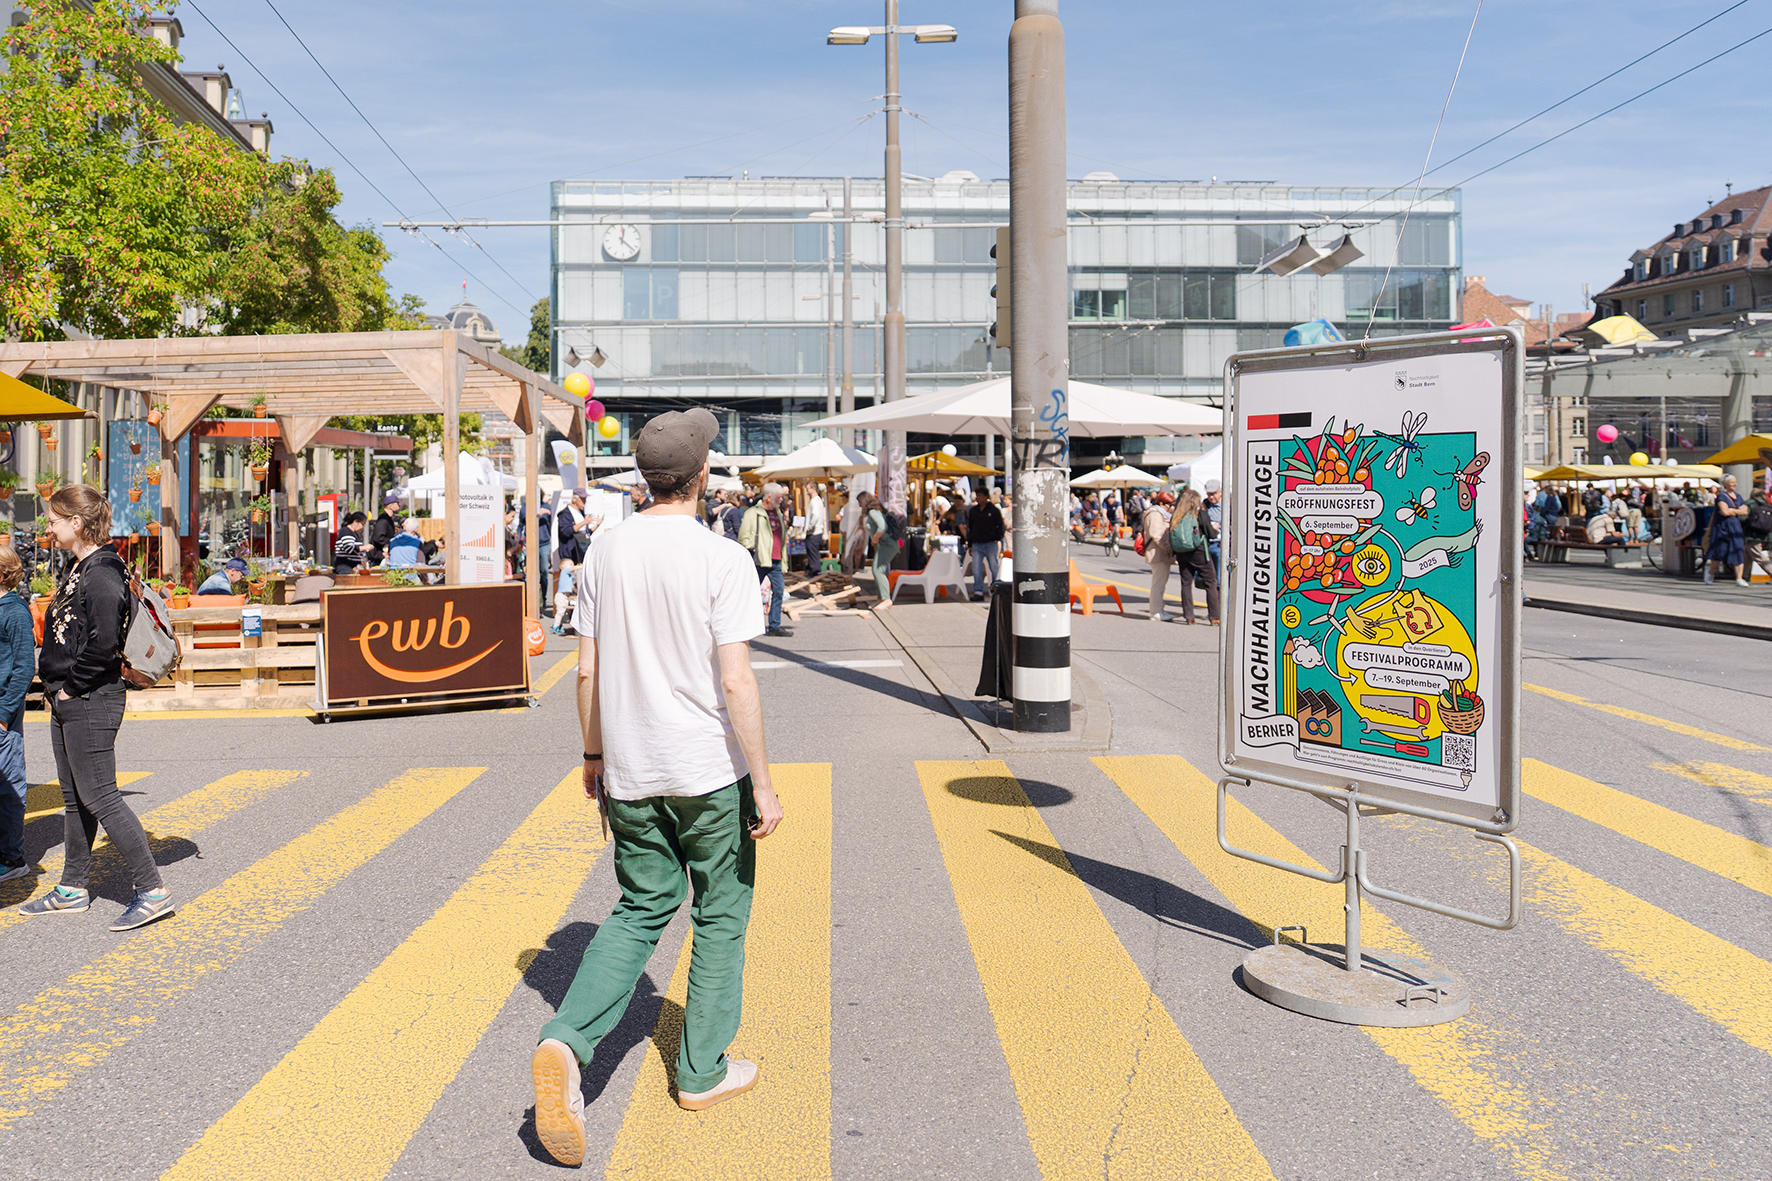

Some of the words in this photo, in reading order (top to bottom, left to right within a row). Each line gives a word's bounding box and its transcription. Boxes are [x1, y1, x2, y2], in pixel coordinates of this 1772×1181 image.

[1284, 497, 1376, 509] ERÖFFNUNGSFEST
[1314, 520, 1353, 530] September
[1419, 557, 1437, 570] 2025
[1251, 454, 1272, 712] NACHHALTIGKEITSTAGE
[1352, 651, 1463, 672] FESTIVALPROGRAMM
[1396, 676, 1441, 689] September
[1248, 724, 1294, 738] BERNER
